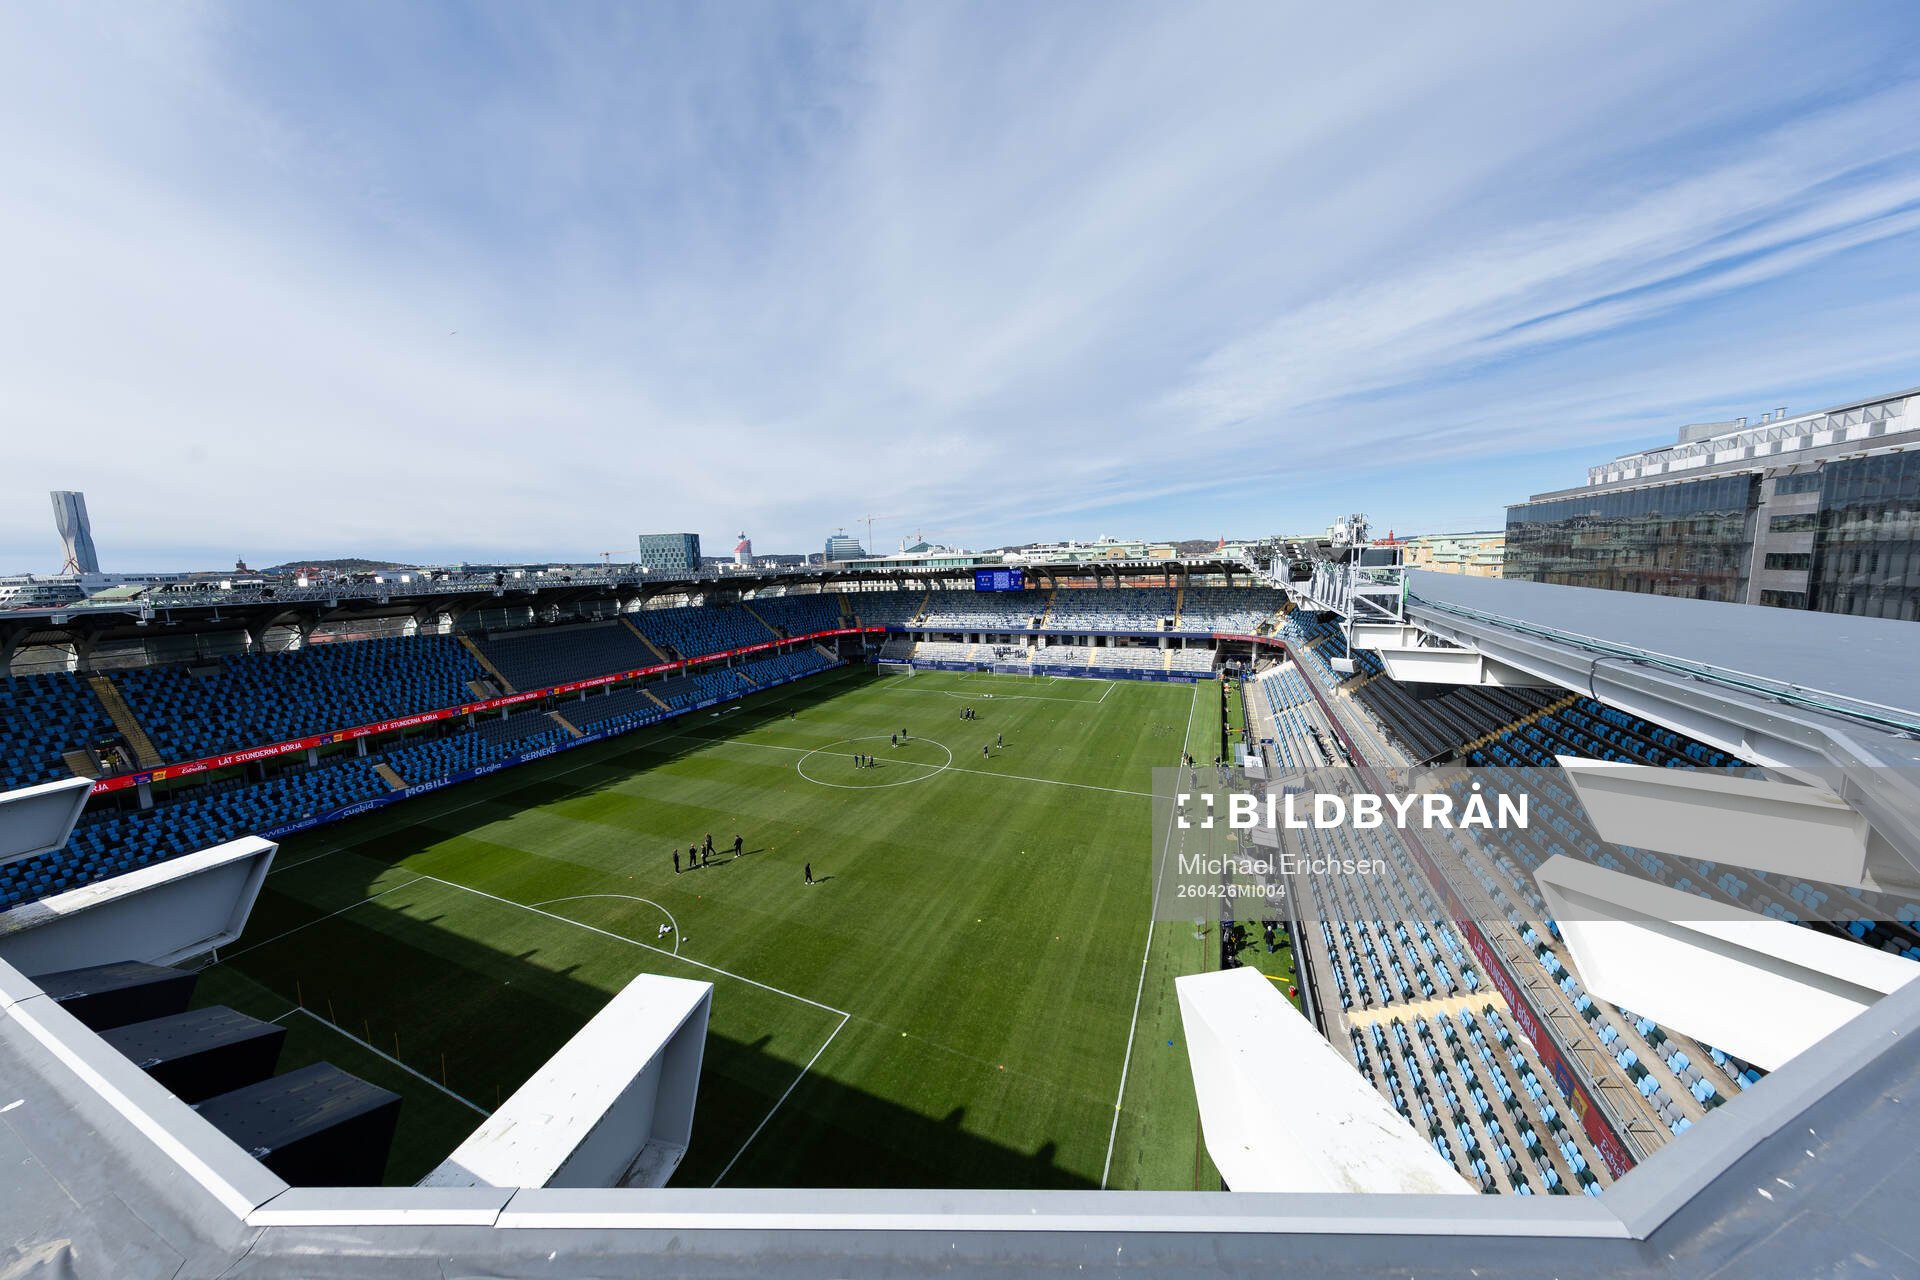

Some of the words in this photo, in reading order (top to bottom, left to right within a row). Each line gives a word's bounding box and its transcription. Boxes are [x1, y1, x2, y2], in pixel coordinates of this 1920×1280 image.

[218, 756, 233, 766] LÅT
[235, 748, 278, 762] STUNDERNA
[281, 742, 302, 753] BÖRJA
[520, 745, 557, 762] SERNEKE
[181, 764, 208, 774] Estrella
[91, 783, 109, 793] RJA
[405, 778, 451, 798] MOBILL
